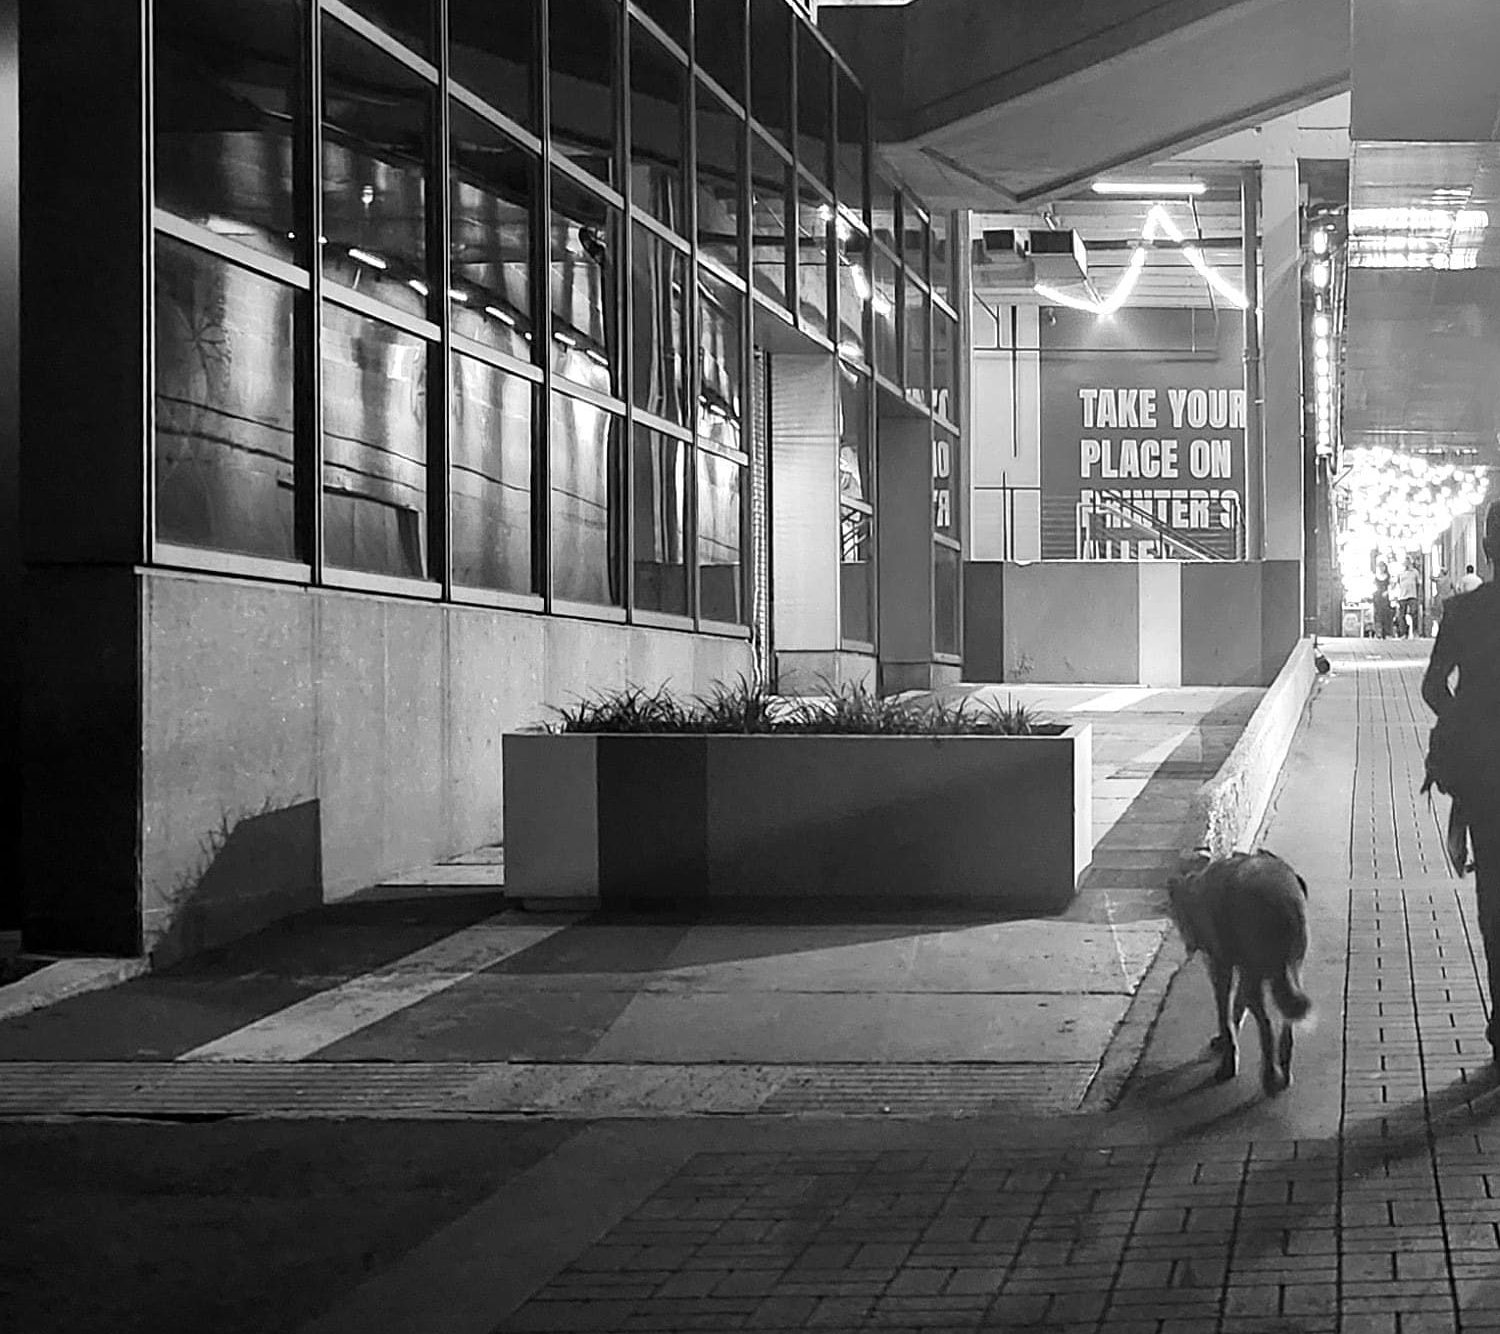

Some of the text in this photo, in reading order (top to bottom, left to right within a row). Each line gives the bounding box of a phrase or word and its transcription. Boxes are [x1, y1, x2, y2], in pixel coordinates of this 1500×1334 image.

[1079, 388, 1247, 430] TAKE YOUR
[1080, 439, 1232, 479] PLACE ON
